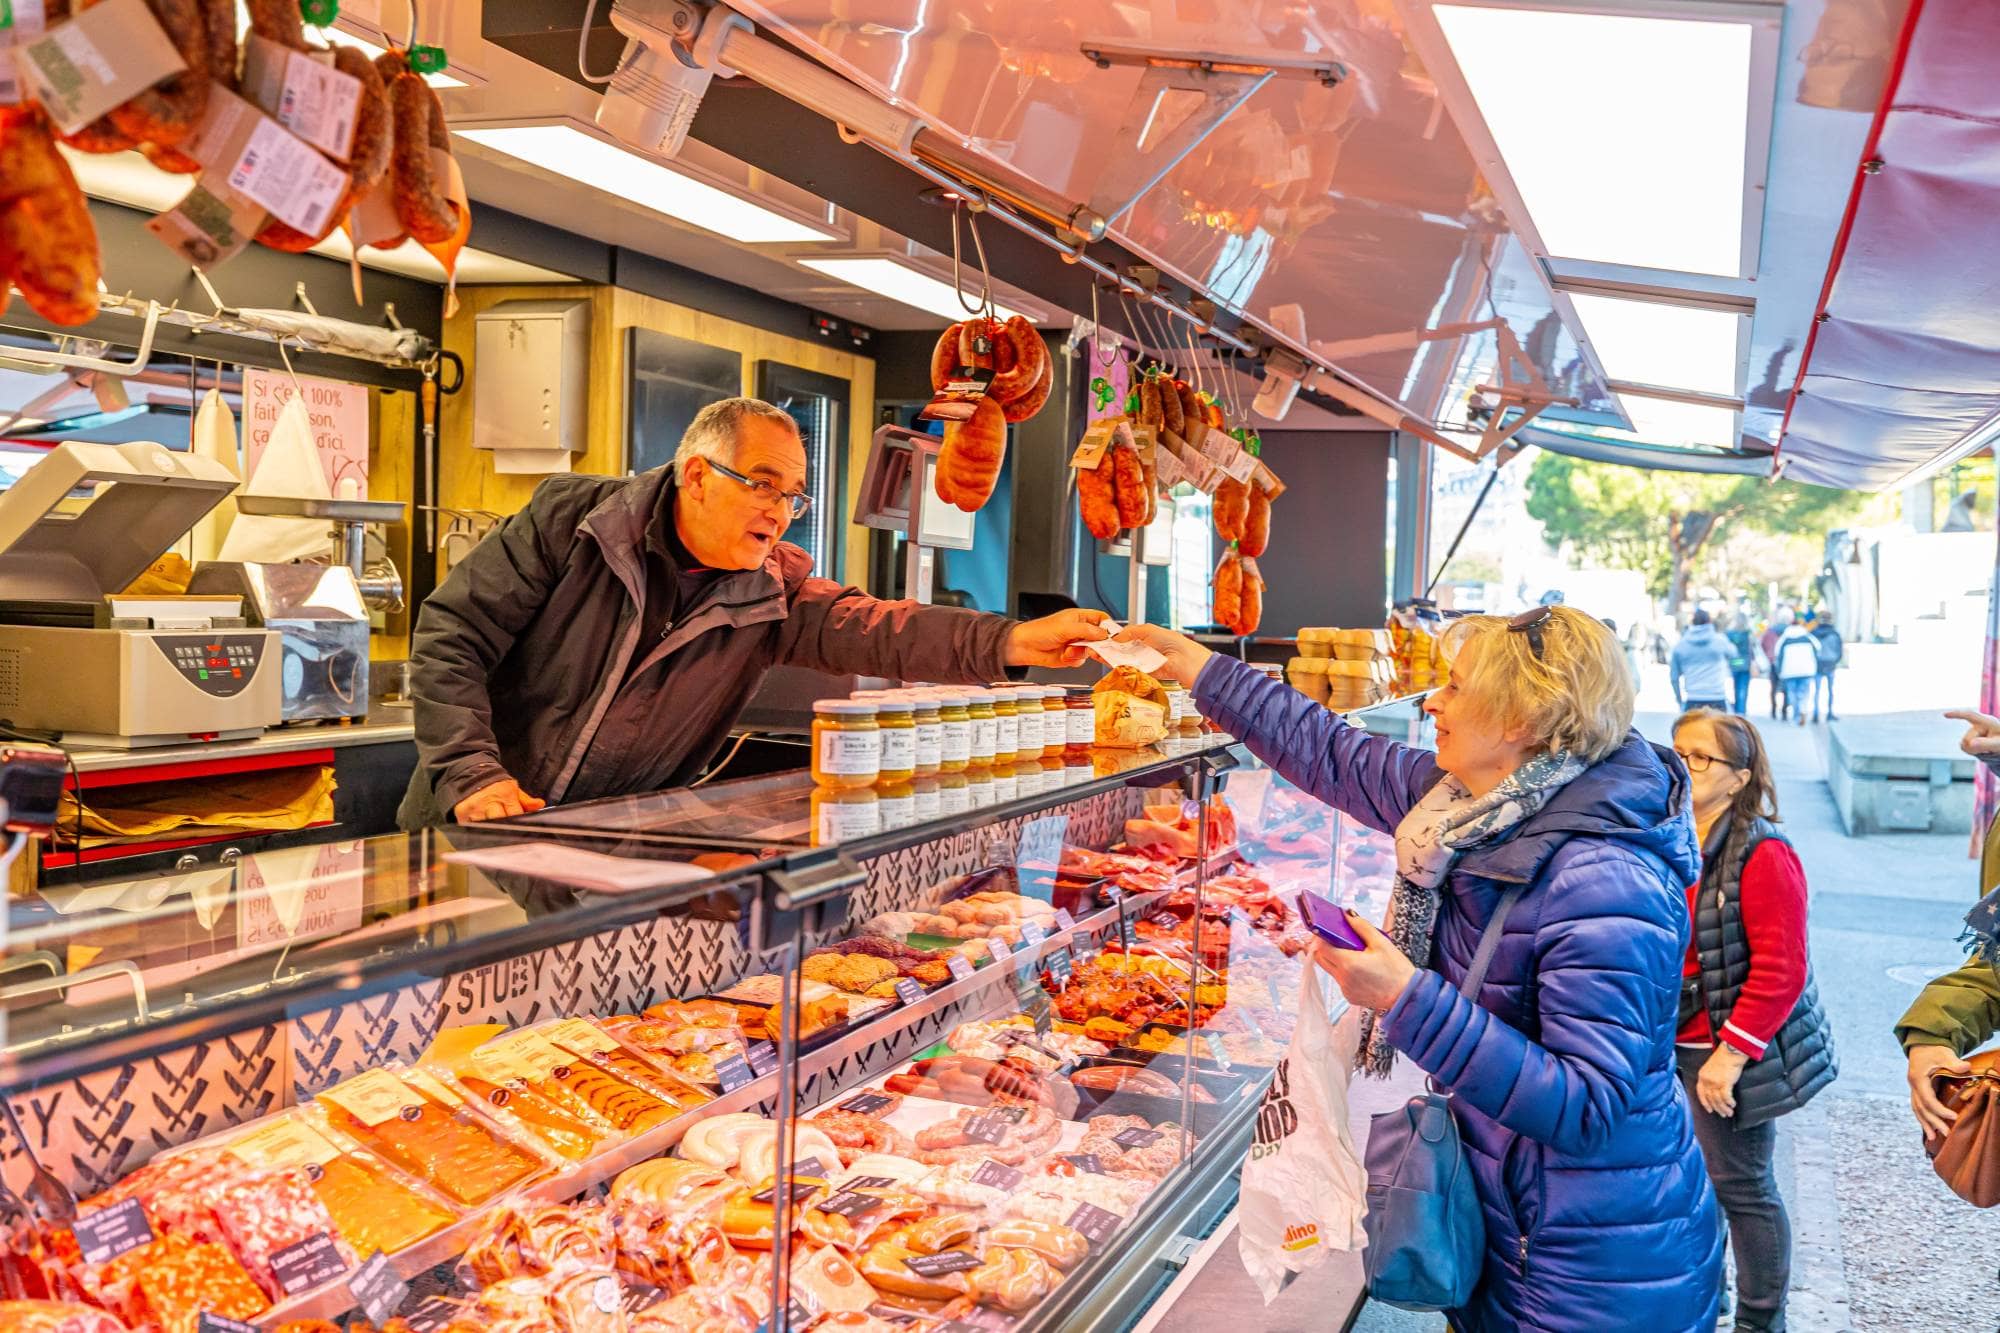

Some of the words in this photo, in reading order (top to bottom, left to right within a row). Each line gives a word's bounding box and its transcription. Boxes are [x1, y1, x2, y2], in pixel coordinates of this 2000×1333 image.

[253, 379, 267, 398] Si
[311, 387, 343, 408] 100%
[254, 402, 277, 421] fait
[943, 829, 980, 861] STUBY
[456, 950, 546, 1015] STUBY
